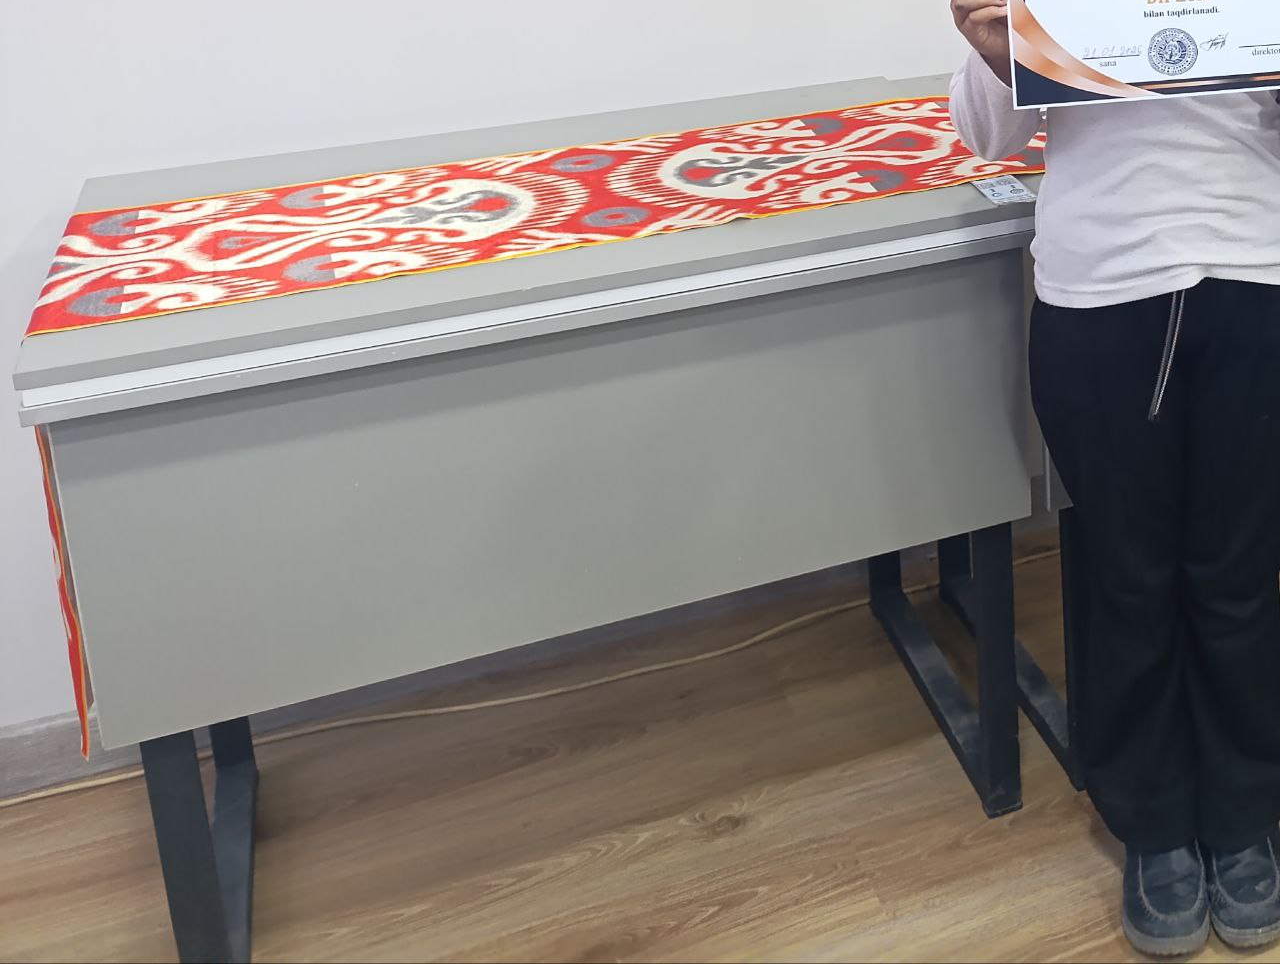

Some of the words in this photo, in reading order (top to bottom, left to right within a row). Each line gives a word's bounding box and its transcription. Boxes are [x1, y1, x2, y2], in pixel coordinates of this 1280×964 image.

[1143, 10, 1165, 18] bilan
[1167, 6, 1220, 17] taqdirlanadi.
[1251, 47, 1280, 56] direktor
